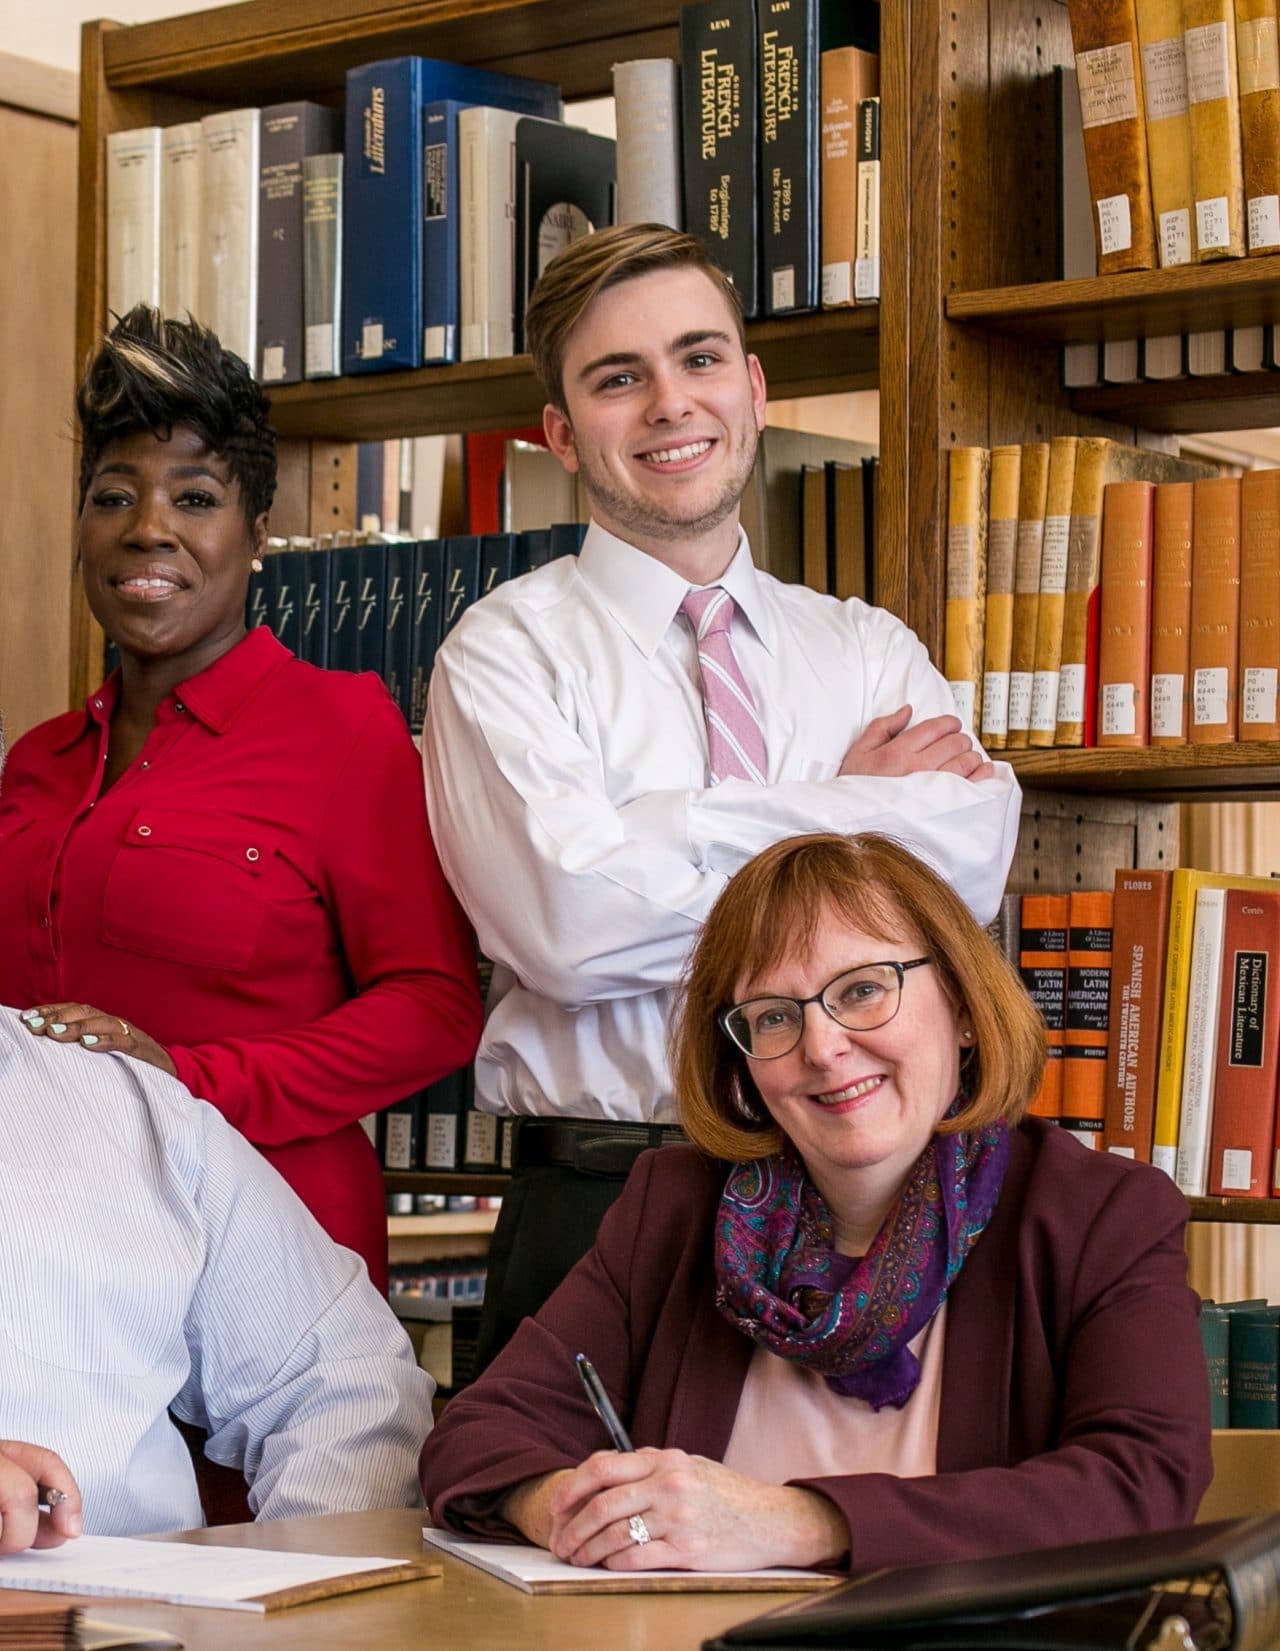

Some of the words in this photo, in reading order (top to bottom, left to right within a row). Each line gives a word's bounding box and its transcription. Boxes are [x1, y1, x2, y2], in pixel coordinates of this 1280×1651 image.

[701, 48, 719, 160] LITERATURE
[717, 63, 735, 138] FRENCH
[763, 30, 779, 144] LITERATURE
[778, 45, 794, 121] FRENCH
[1123, 880, 1153, 891] FLORES
[1034, 969, 1063, 977] MODERN
[1038, 979, 1063, 988] LATIN
[1079, 969, 1110, 977] MODERN
[1083, 979, 1109, 988] LATIN
[1122, 985, 1131, 1001] THE
[1130, 944, 1144, 999] SPANISH
[1237, 957, 1249, 1003] Mexican
[1248, 958, 1262, 1014] Dictionary
[1032, 991, 1063, 1000] ERICAN
[1068, 1002, 1108, 1010] LITERATURE
[1119, 1002, 1130, 1051] TWENTIETH
[1126, 1003, 1140, 1068] AMERICAN
[1234, 1006, 1247, 1060] Literature
[1249, 1017, 1259, 1031] of
[1118, 1052, 1127, 1089] CENTURY
[1123, 1071, 1137, 1132] AUTHORS
